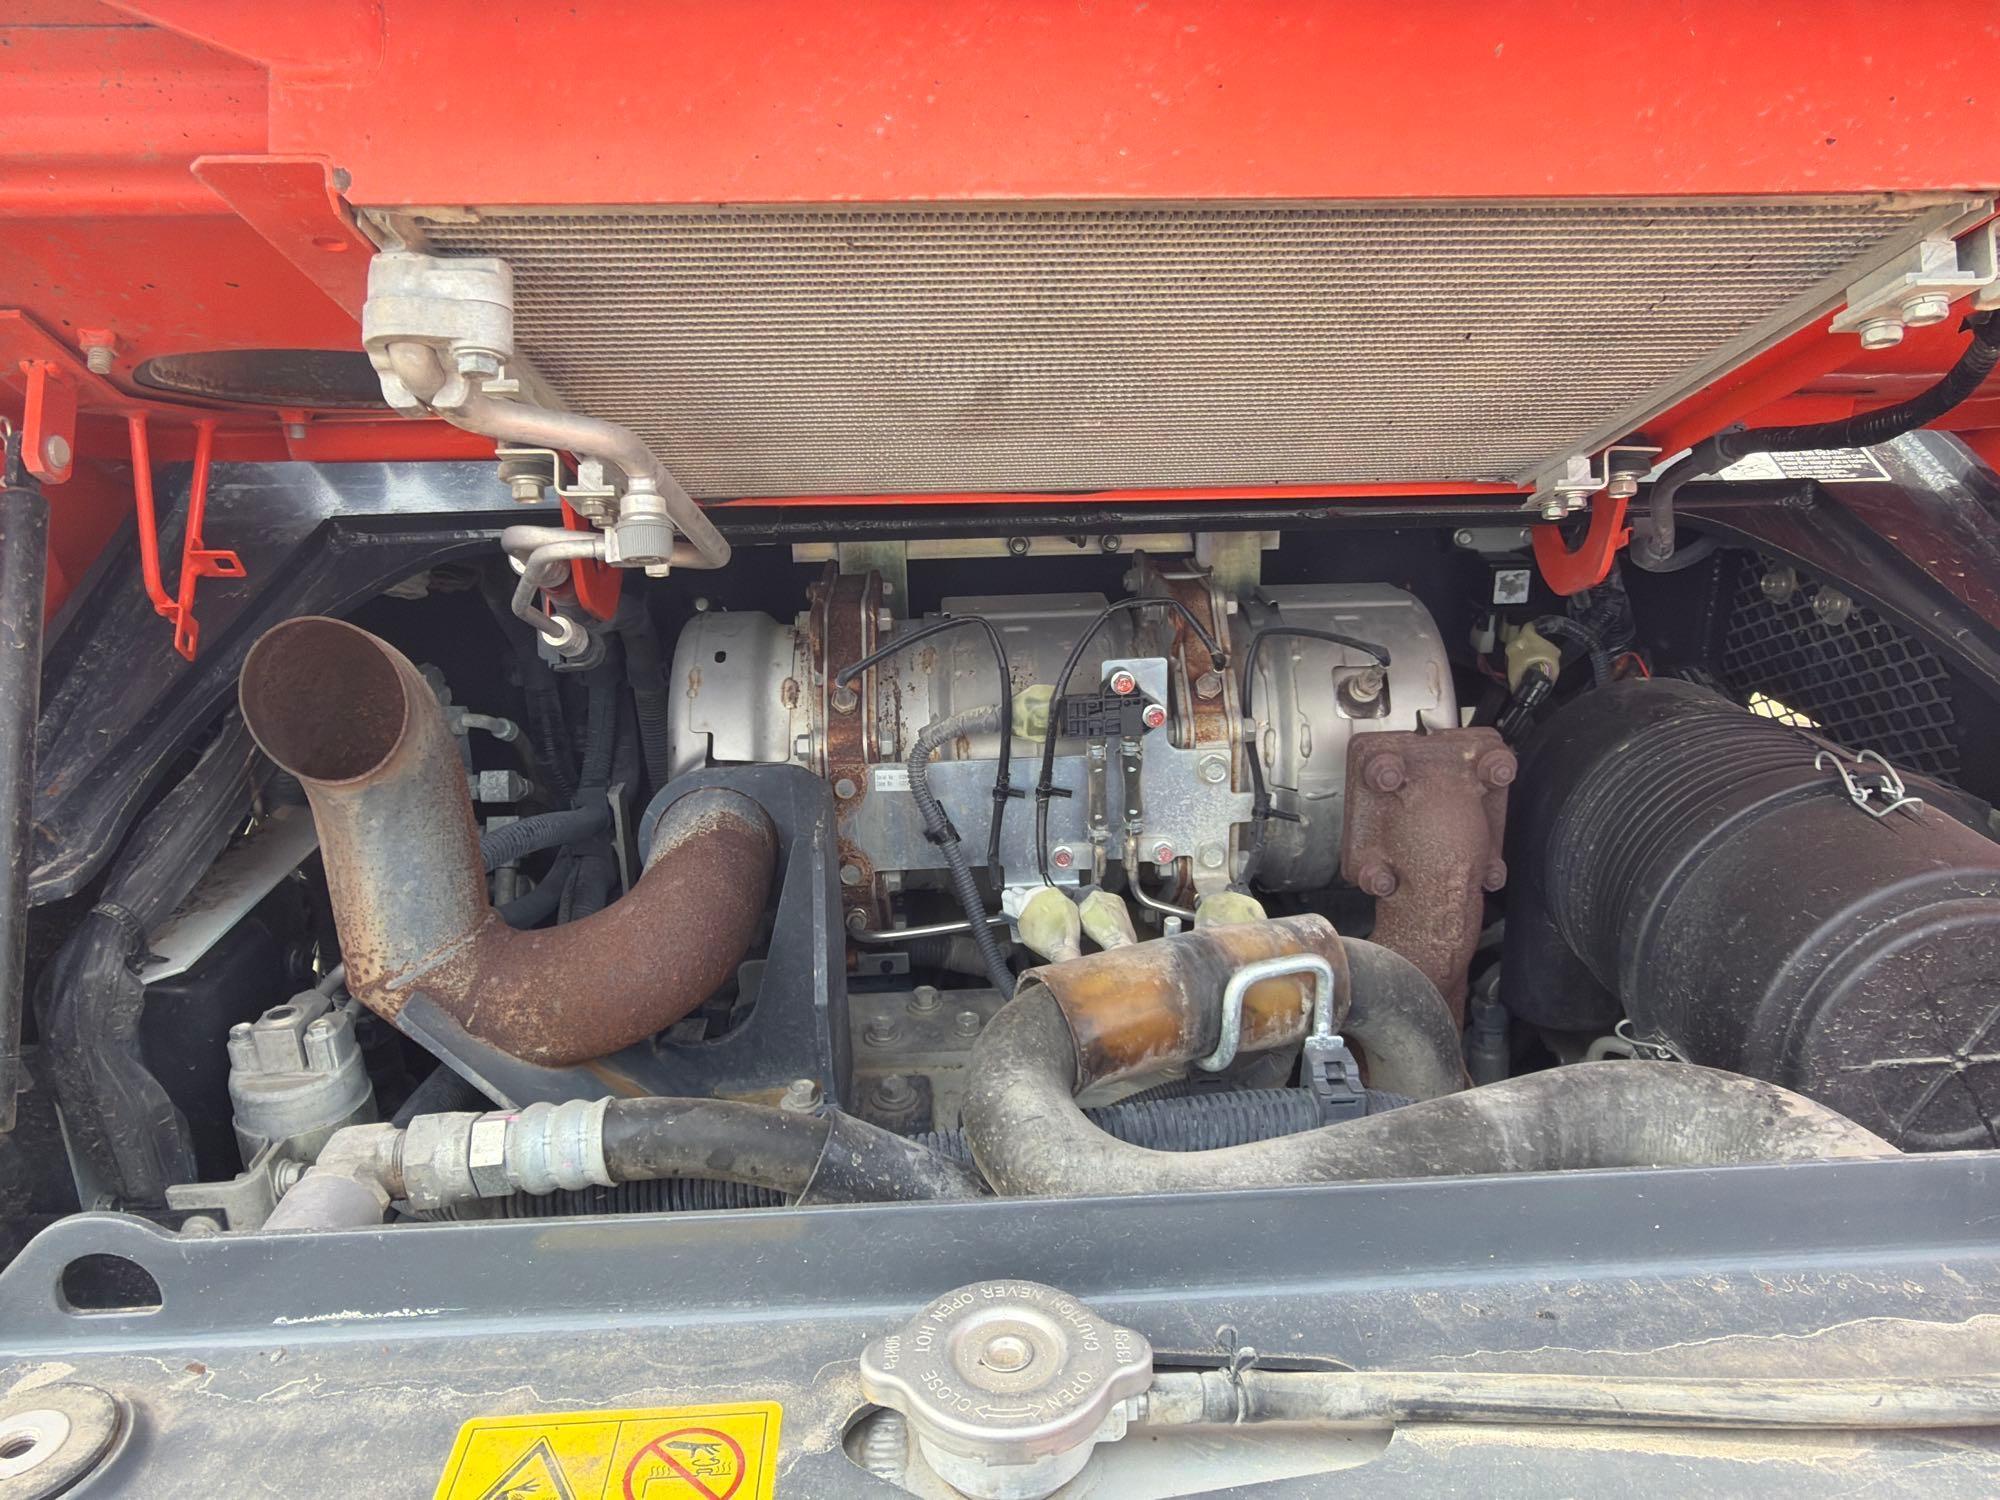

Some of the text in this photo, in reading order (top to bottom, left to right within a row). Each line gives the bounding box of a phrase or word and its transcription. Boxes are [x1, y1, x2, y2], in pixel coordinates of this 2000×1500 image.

[915, 1286, 1100, 1353] CAUTION NEVER OPEN HOT
[1113, 1329, 1133, 1364] 13PSI
[920, 1369, 971, 1411] CLOSE
[1048, 1371, 1093, 1410] OPEN
